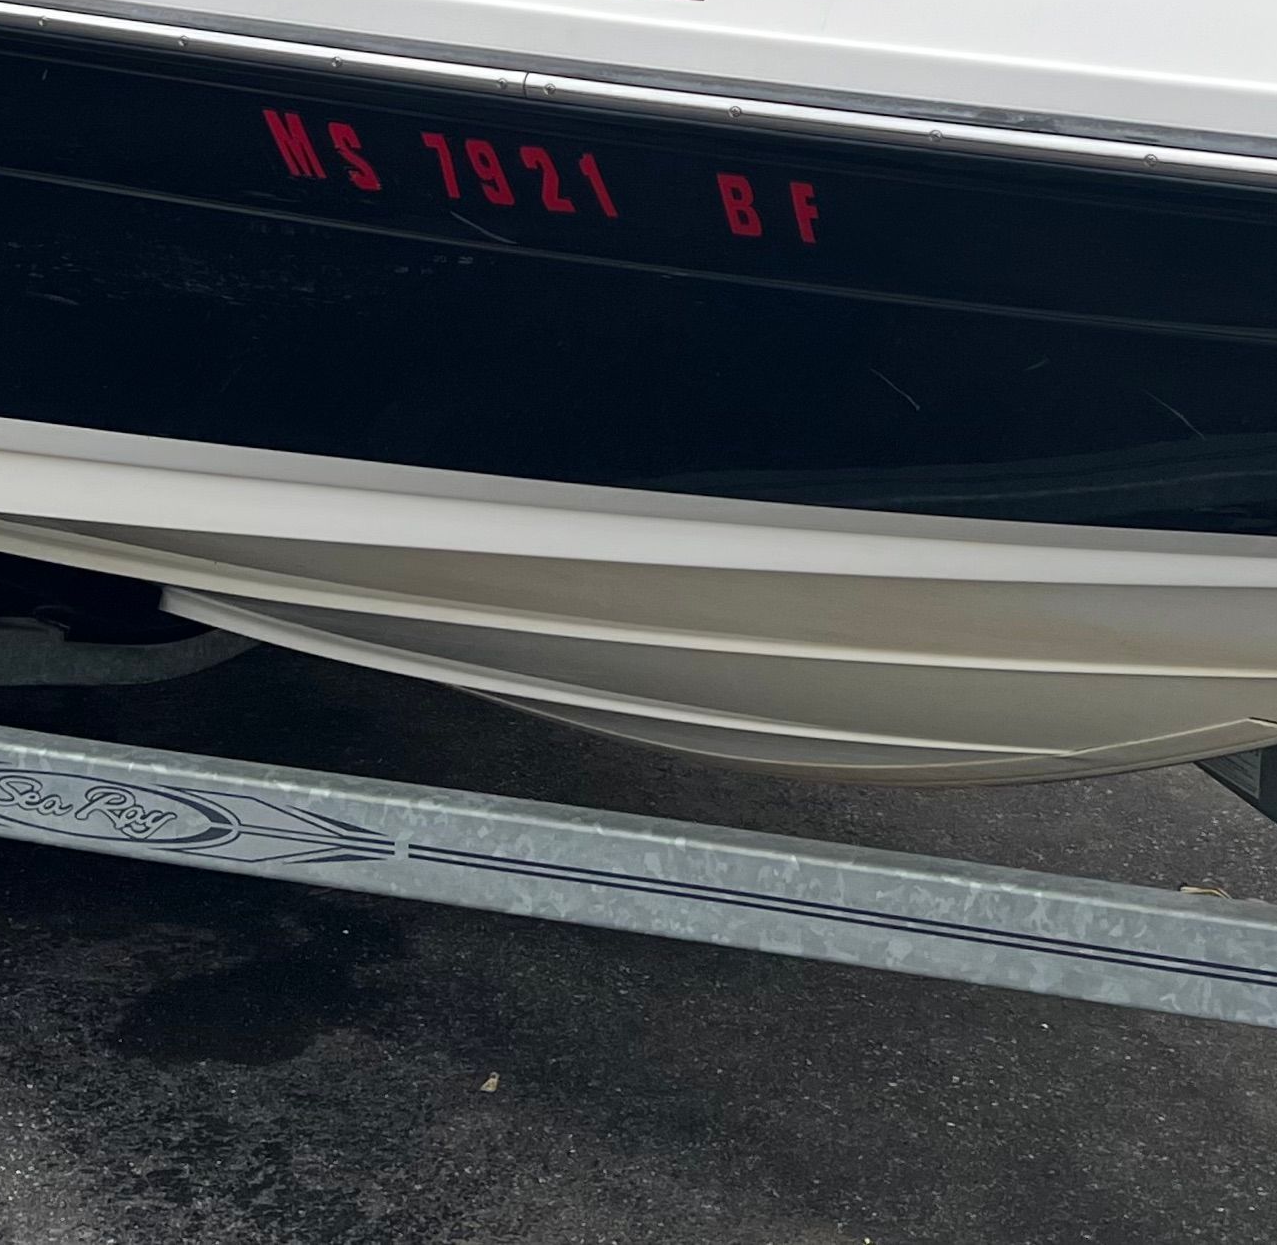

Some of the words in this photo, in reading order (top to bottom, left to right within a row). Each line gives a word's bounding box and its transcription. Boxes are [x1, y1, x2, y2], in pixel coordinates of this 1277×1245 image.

[263, 108, 382, 192] MS
[421, 131, 619, 219] 7921
[74, 786, 178, 840] Ray
